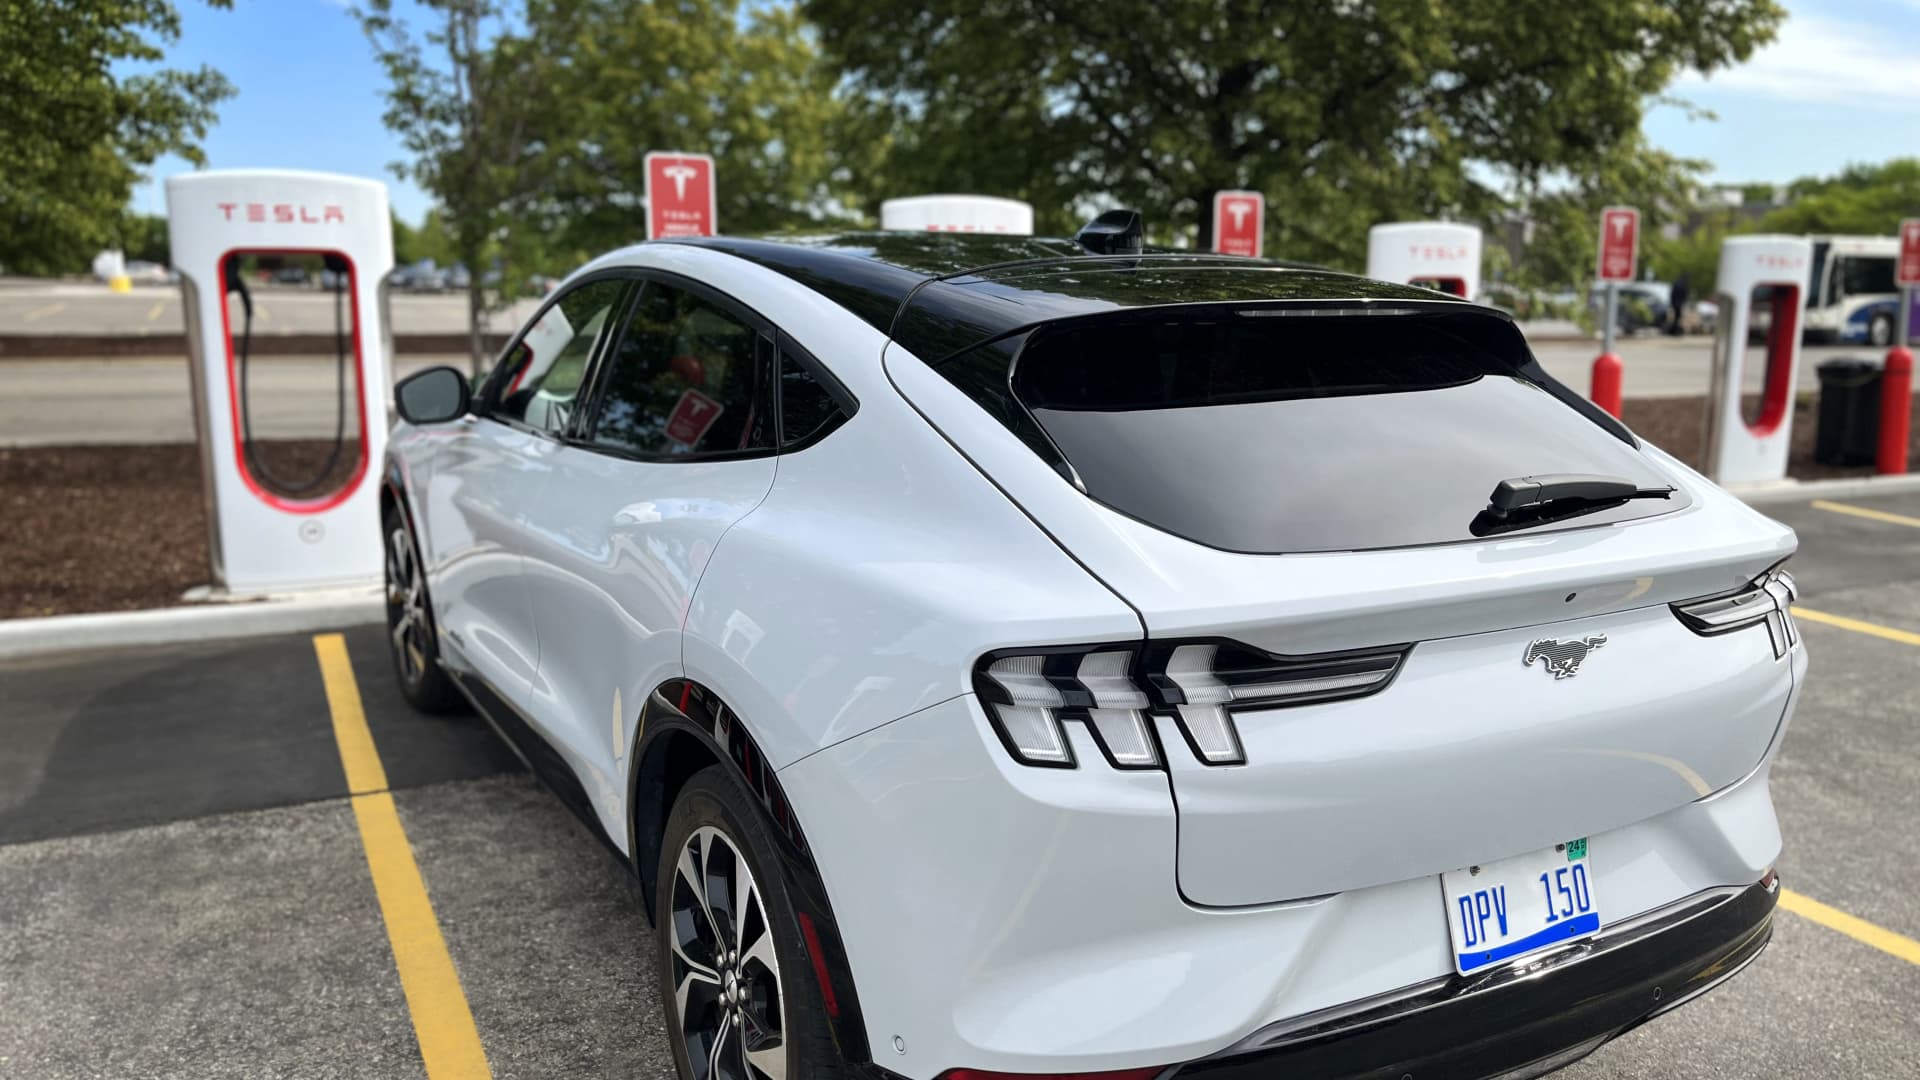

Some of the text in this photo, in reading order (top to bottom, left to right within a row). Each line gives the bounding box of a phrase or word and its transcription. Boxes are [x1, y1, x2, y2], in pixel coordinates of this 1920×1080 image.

[217, 203, 345, 222] TESLA
[1409, 246, 1467, 260] TESLA
[1568, 840, 1580, 853] 24
[1458, 863, 1591, 948] DPV 150
